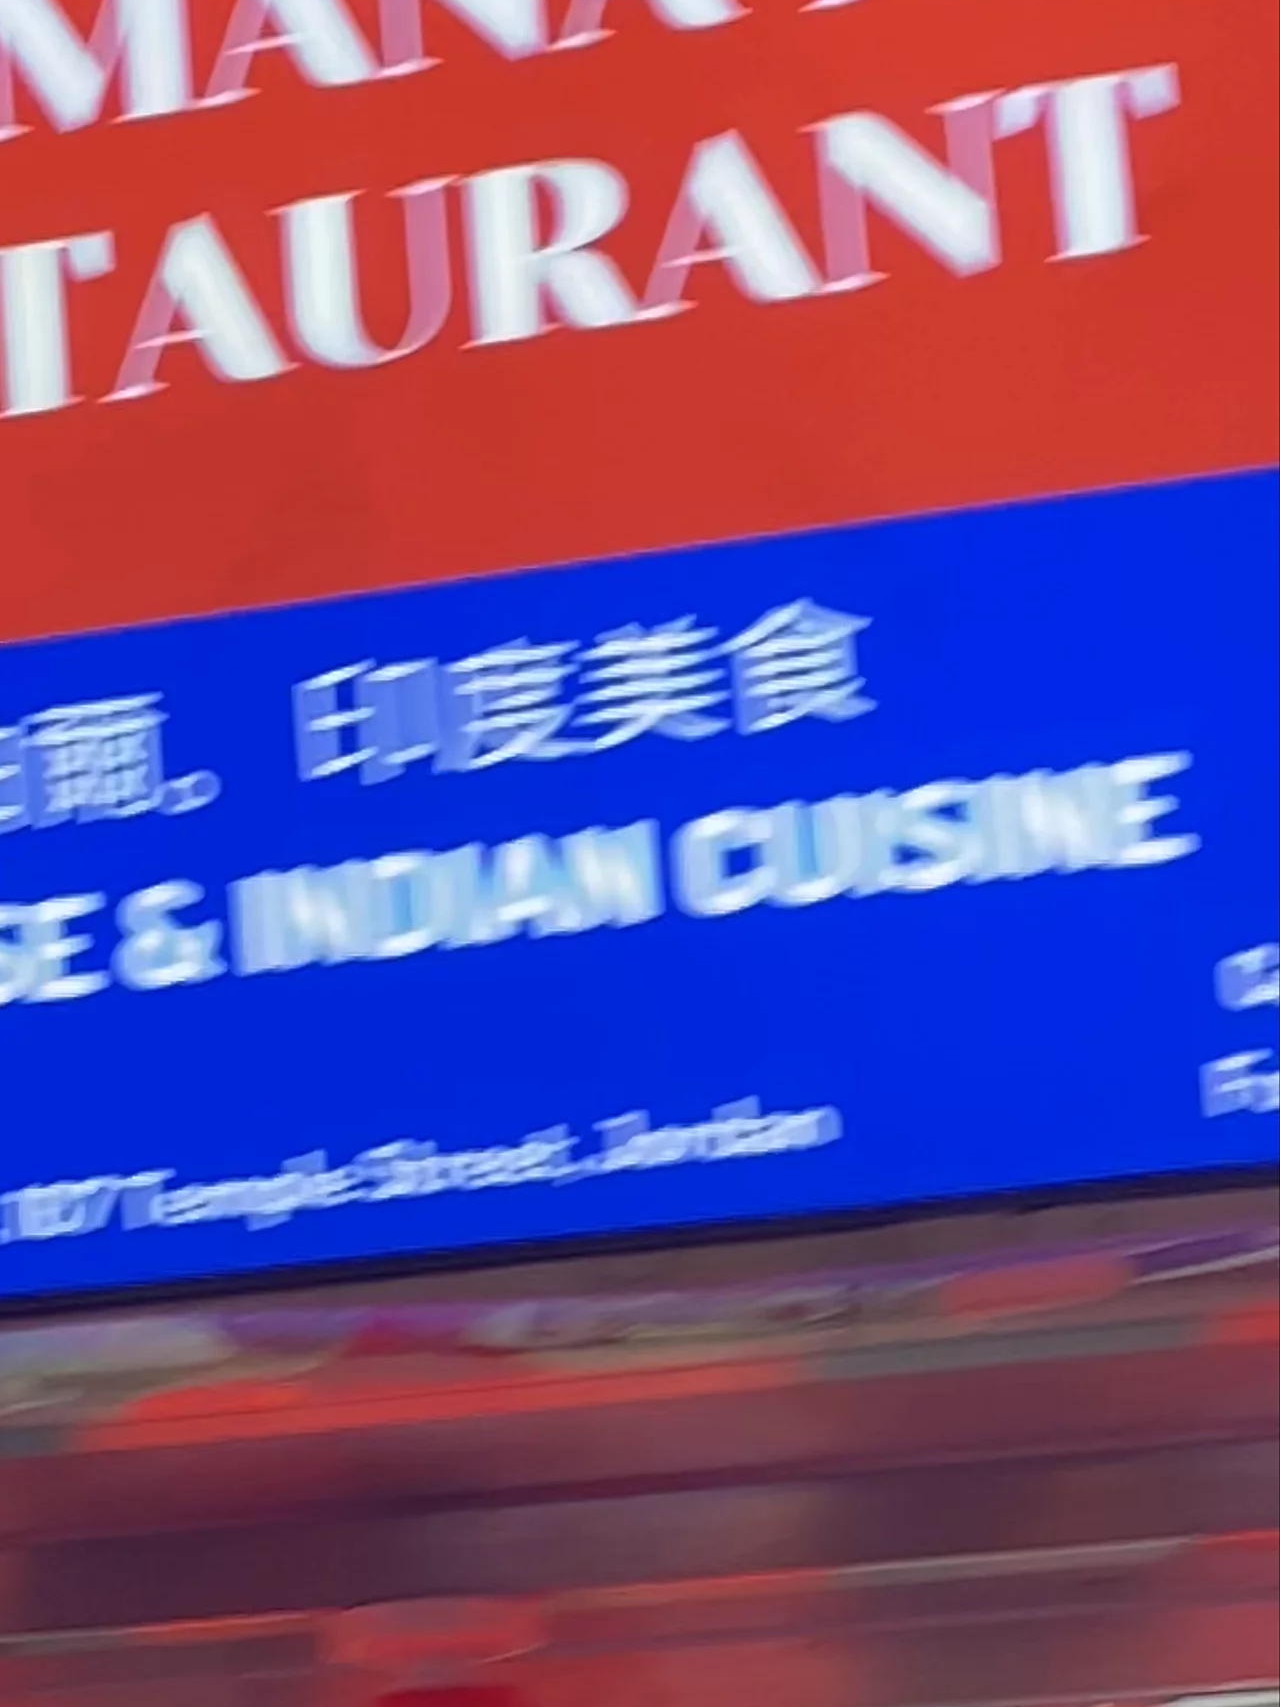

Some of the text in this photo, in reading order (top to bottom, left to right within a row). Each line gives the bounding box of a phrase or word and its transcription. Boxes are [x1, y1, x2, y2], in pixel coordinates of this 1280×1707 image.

[112, 878, 227, 992] &
[228, 817, 662, 978] INDIAN
[671, 748, 1203, 919] CUISINE
